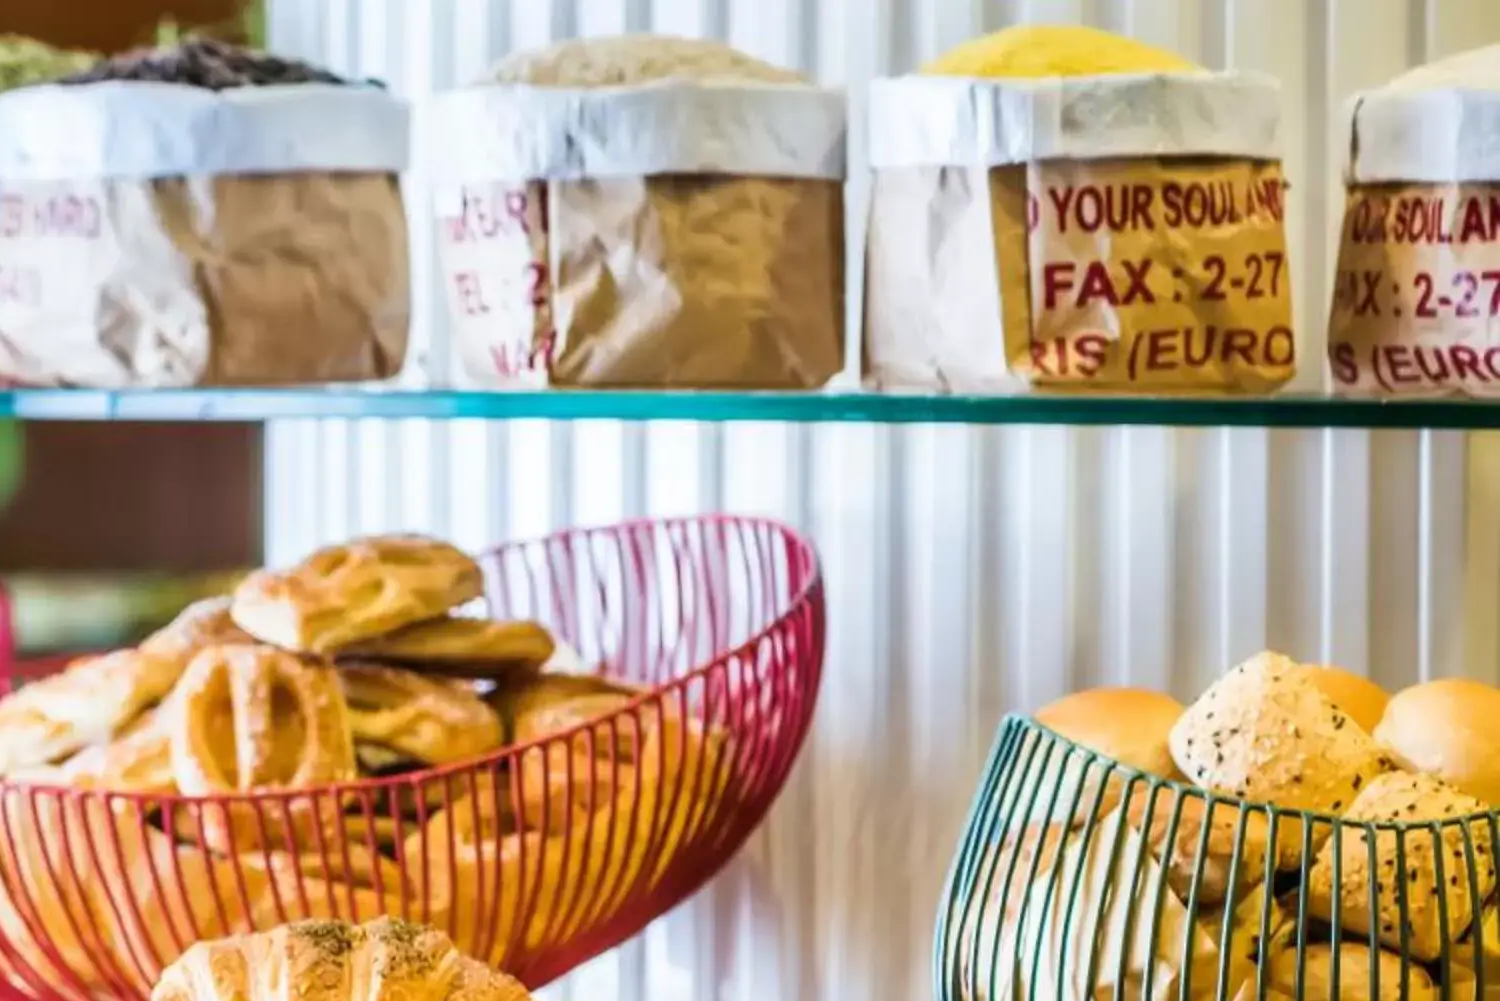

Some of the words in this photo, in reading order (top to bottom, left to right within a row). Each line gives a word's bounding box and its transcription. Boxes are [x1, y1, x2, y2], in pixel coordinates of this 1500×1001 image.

[1050, 184, 1156, 233] YOUR
[1161, 180, 1241, 229] SOUL
[1392, 197, 1454, 244] SOUL
[1043, 258, 1156, 310] FAX
[1201, 252, 1284, 302] 2-27
